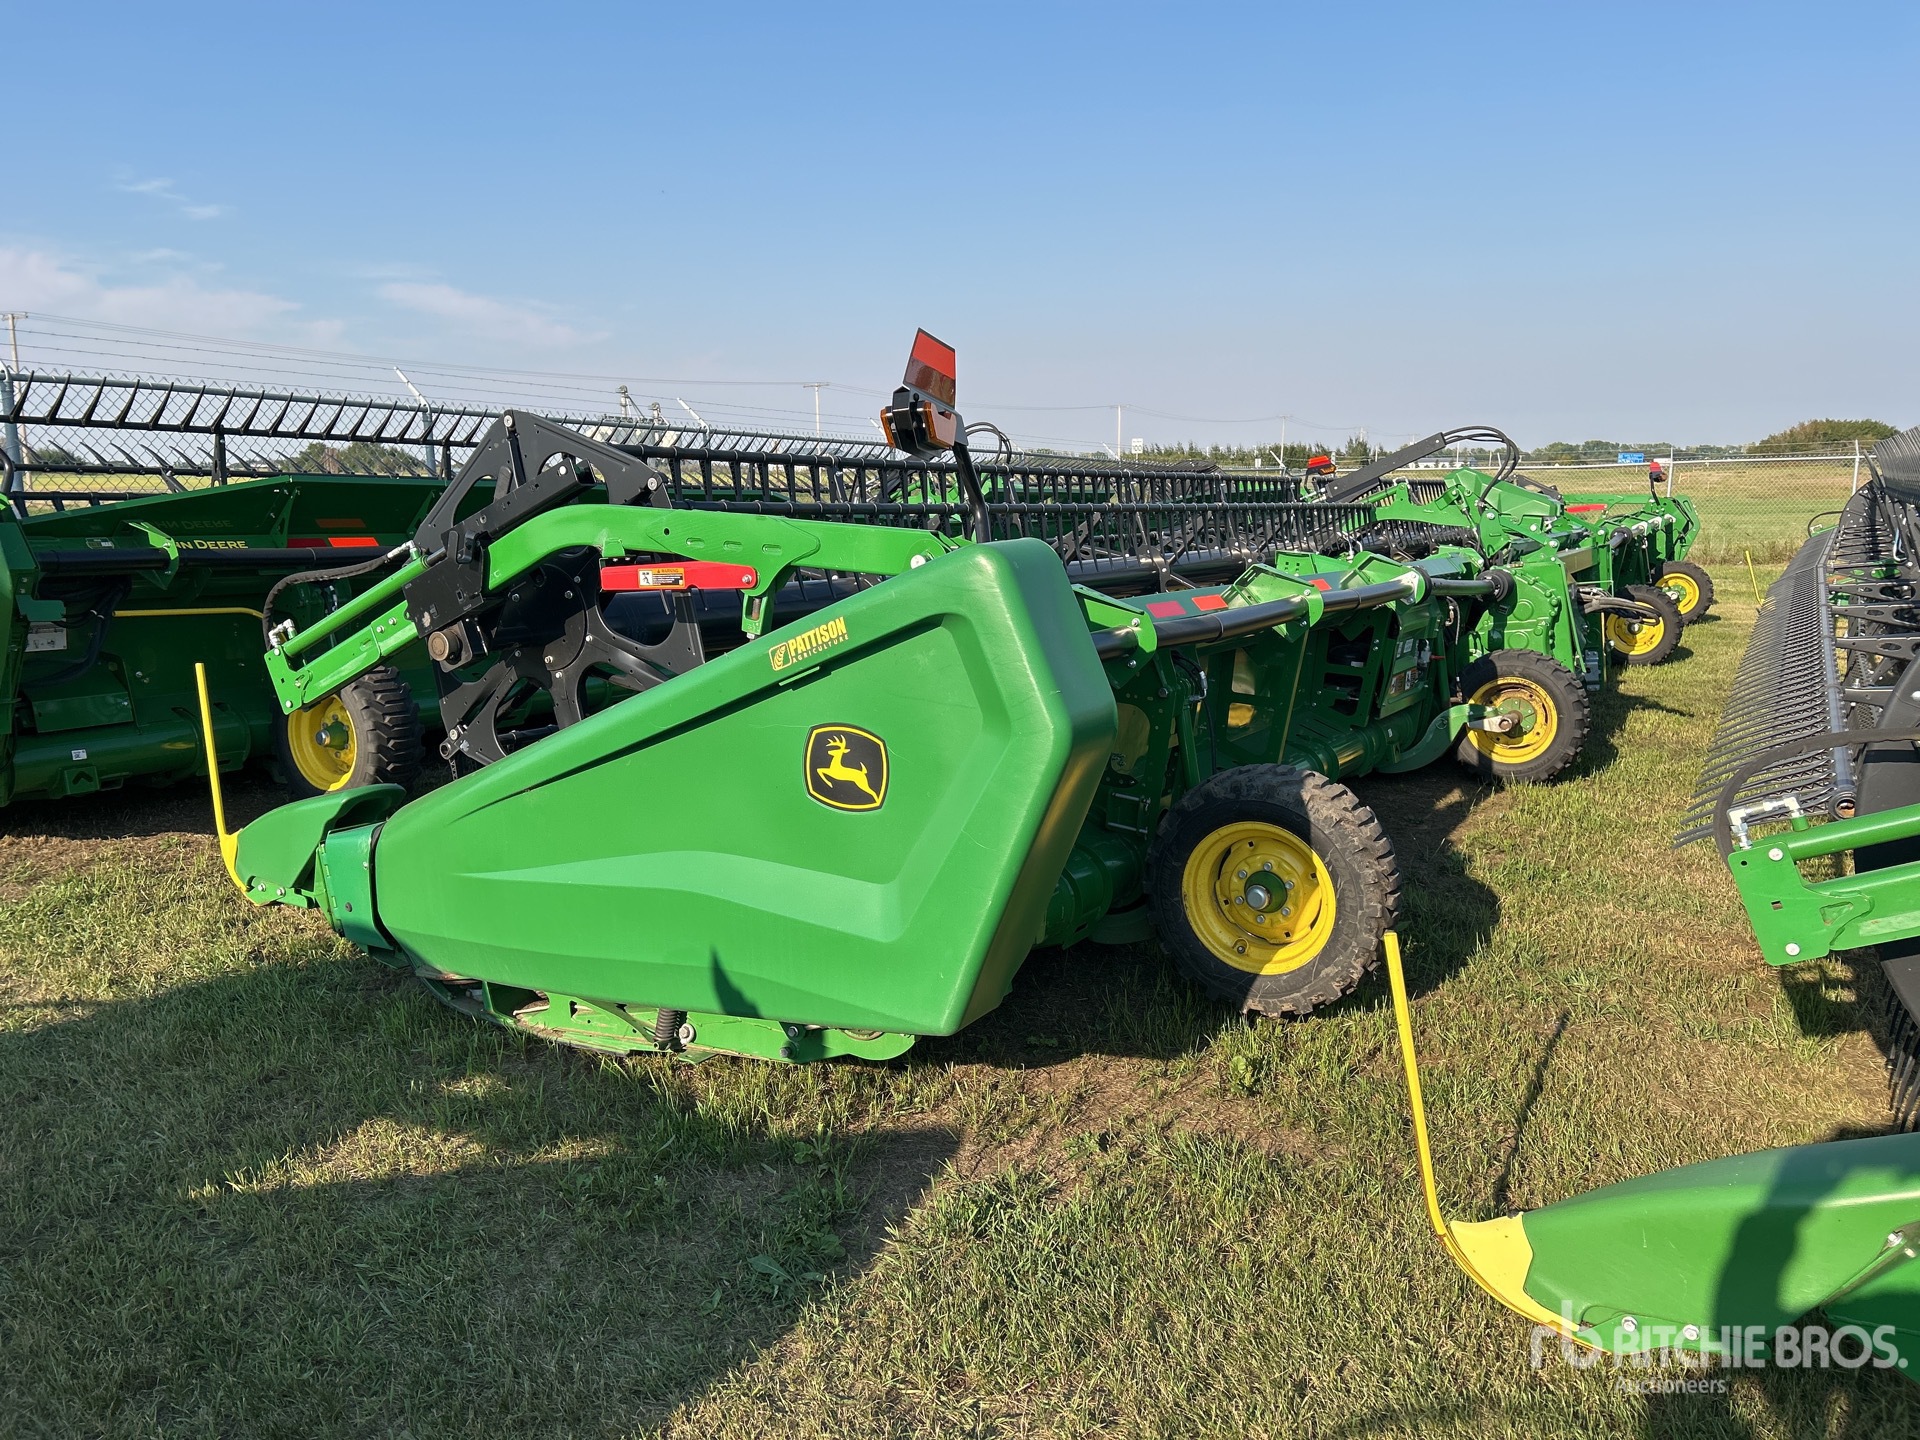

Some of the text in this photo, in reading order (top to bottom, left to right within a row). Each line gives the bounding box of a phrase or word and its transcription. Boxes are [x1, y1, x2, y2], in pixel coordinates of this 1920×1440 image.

[193, 540, 249, 550] DEERE
[787, 616, 847, 657] PATTISON
[792, 634, 849, 664] AGRICULTURE
